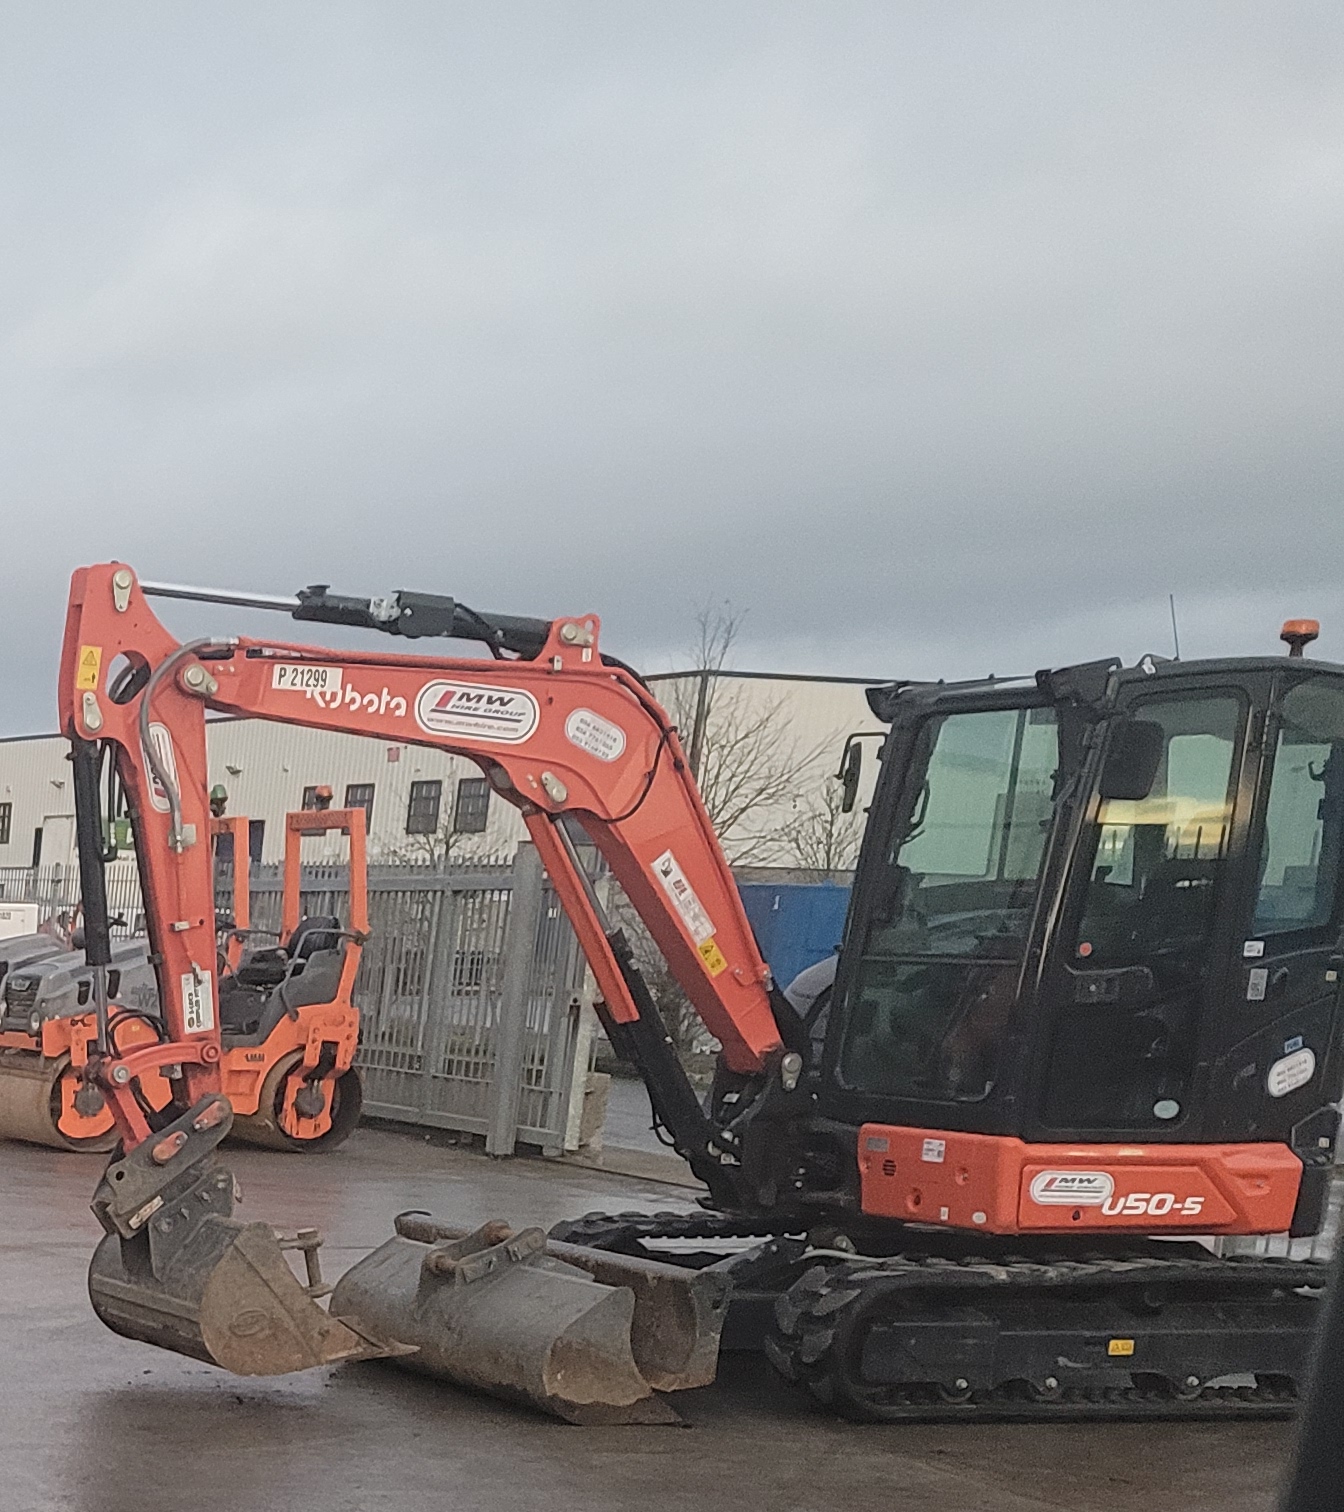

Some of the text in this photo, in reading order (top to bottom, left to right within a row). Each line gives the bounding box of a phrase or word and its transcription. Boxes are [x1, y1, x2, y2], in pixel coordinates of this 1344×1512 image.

[277, 668, 328, 688] P 21299
[456, 691, 516, 707] MW
